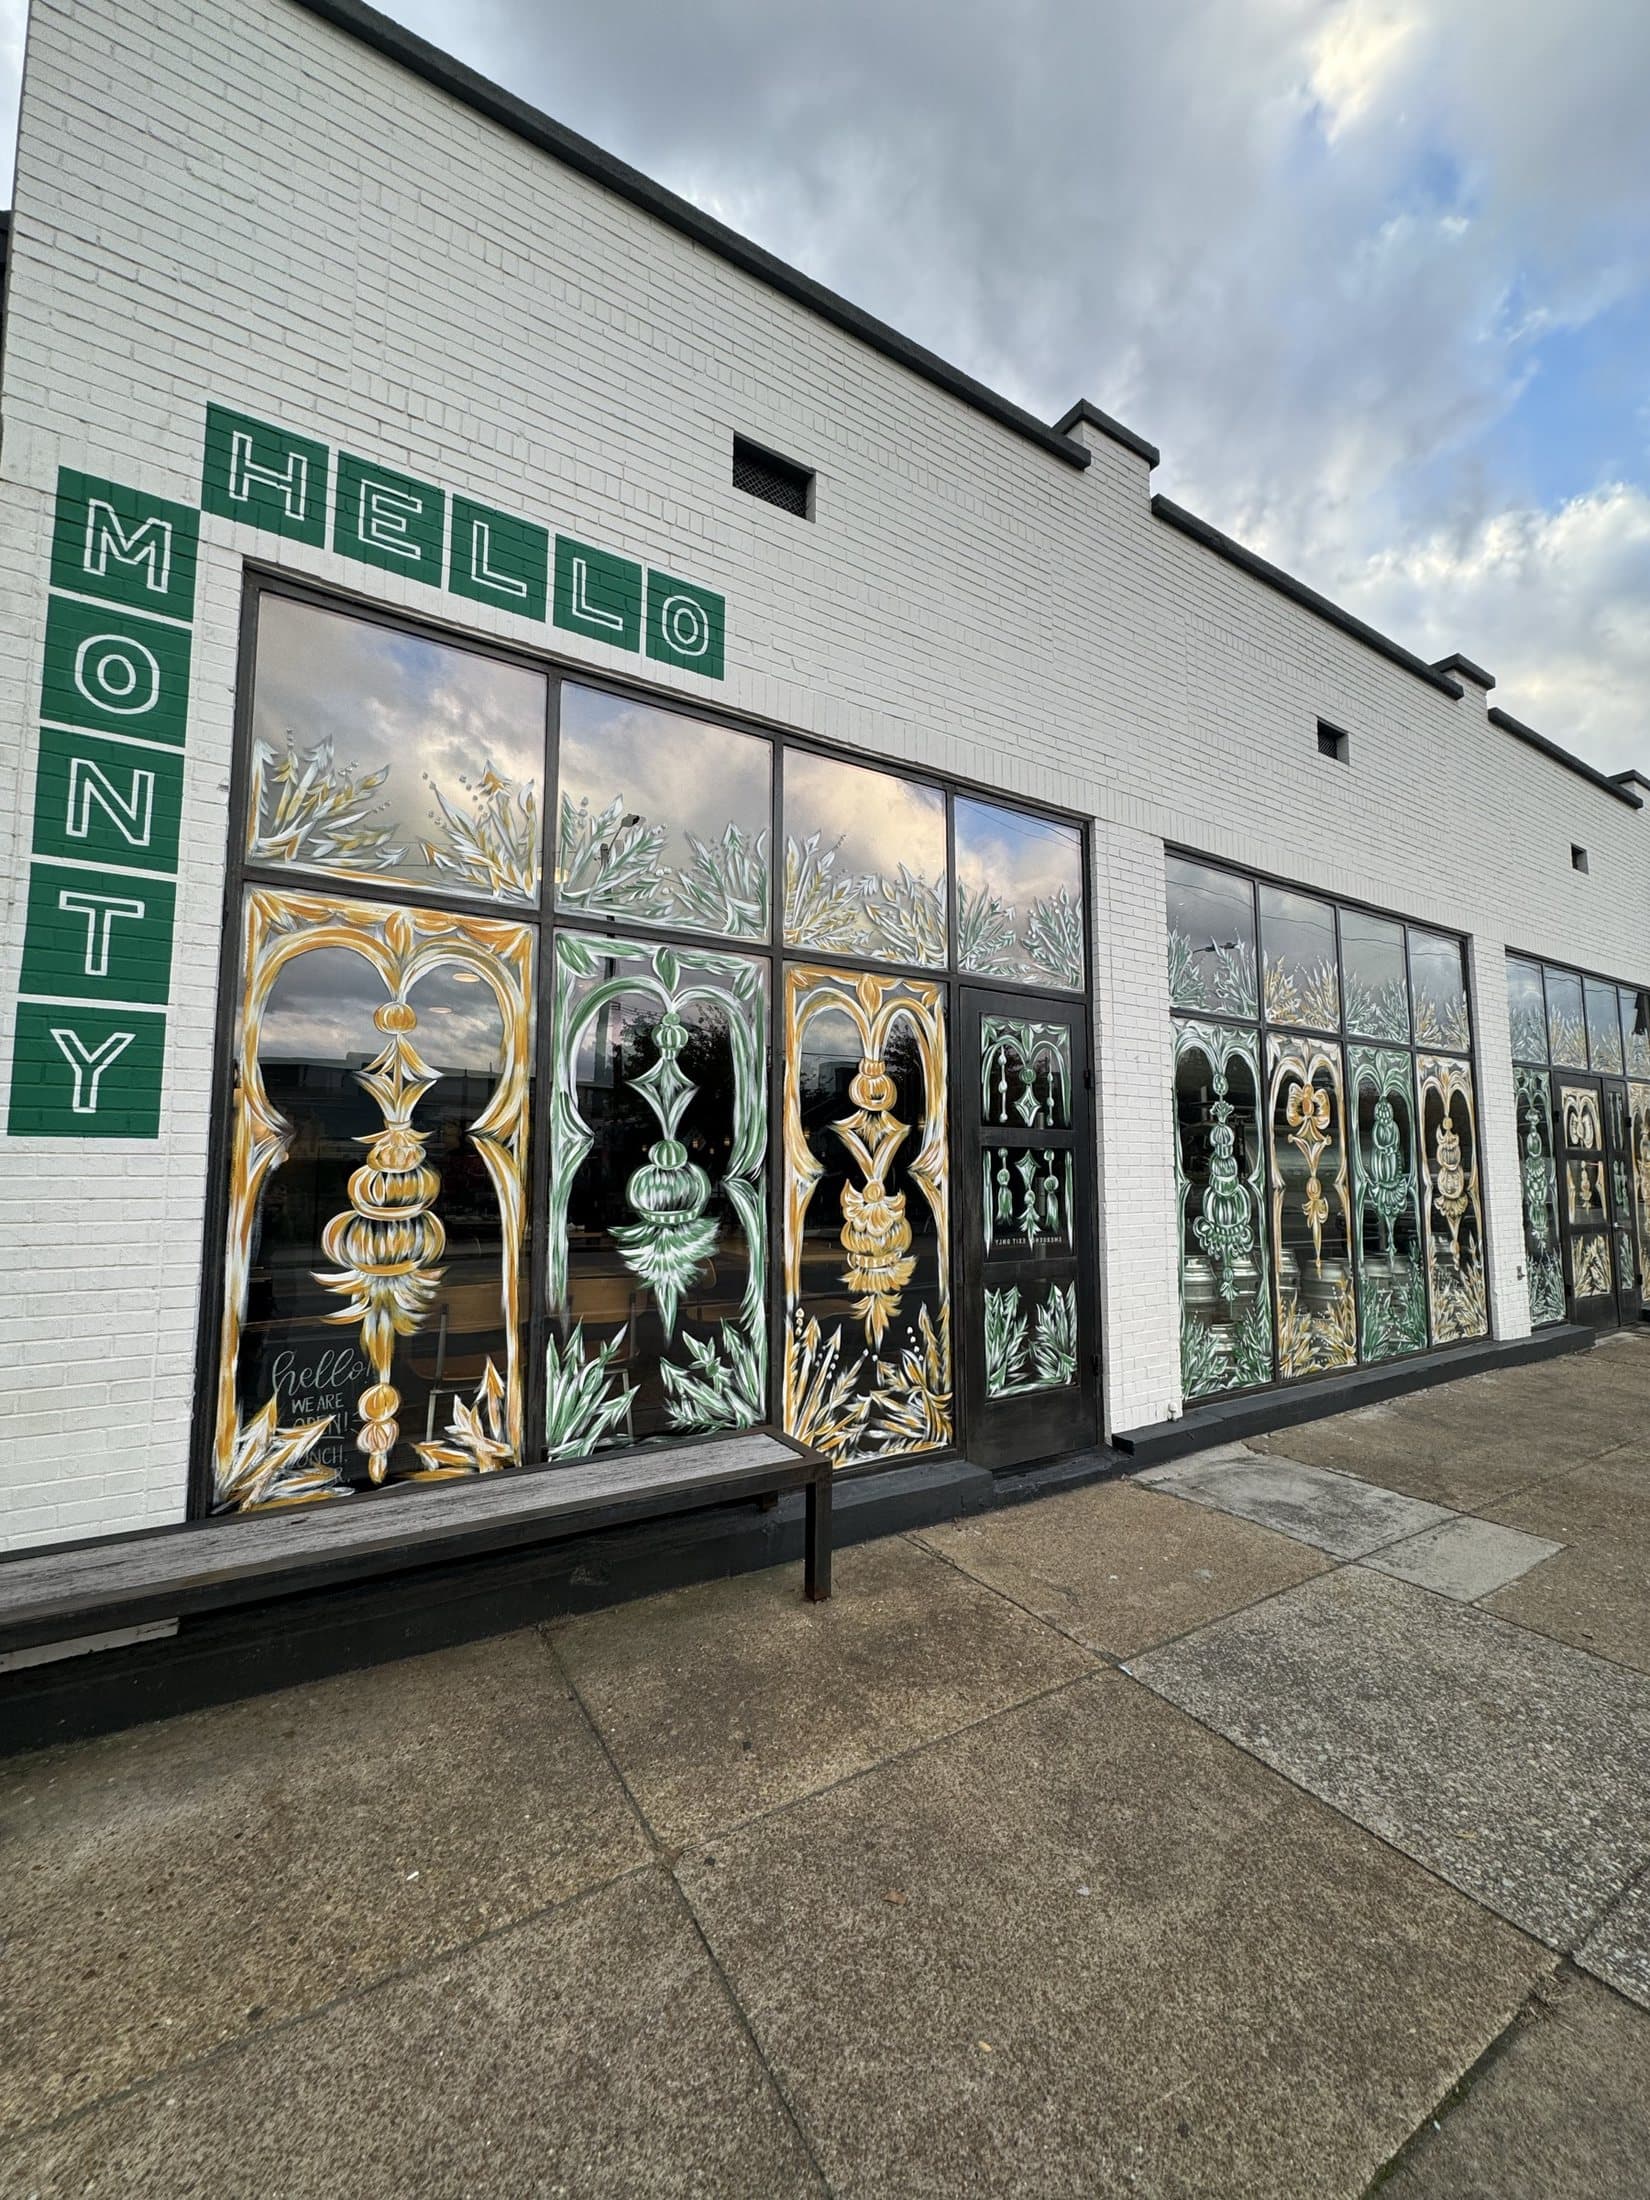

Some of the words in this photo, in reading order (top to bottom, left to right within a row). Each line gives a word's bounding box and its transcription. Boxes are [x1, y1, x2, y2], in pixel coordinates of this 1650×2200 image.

[229, 431, 709, 656] HELLO
[50, 498, 172, 1114] MONTY
[272, 1348, 371, 1396] hello!
[291, 1396, 315, 1414] WE
[316, 1392, 344, 1411] ARE
[291, 1444, 348, 1468] UNCH.
